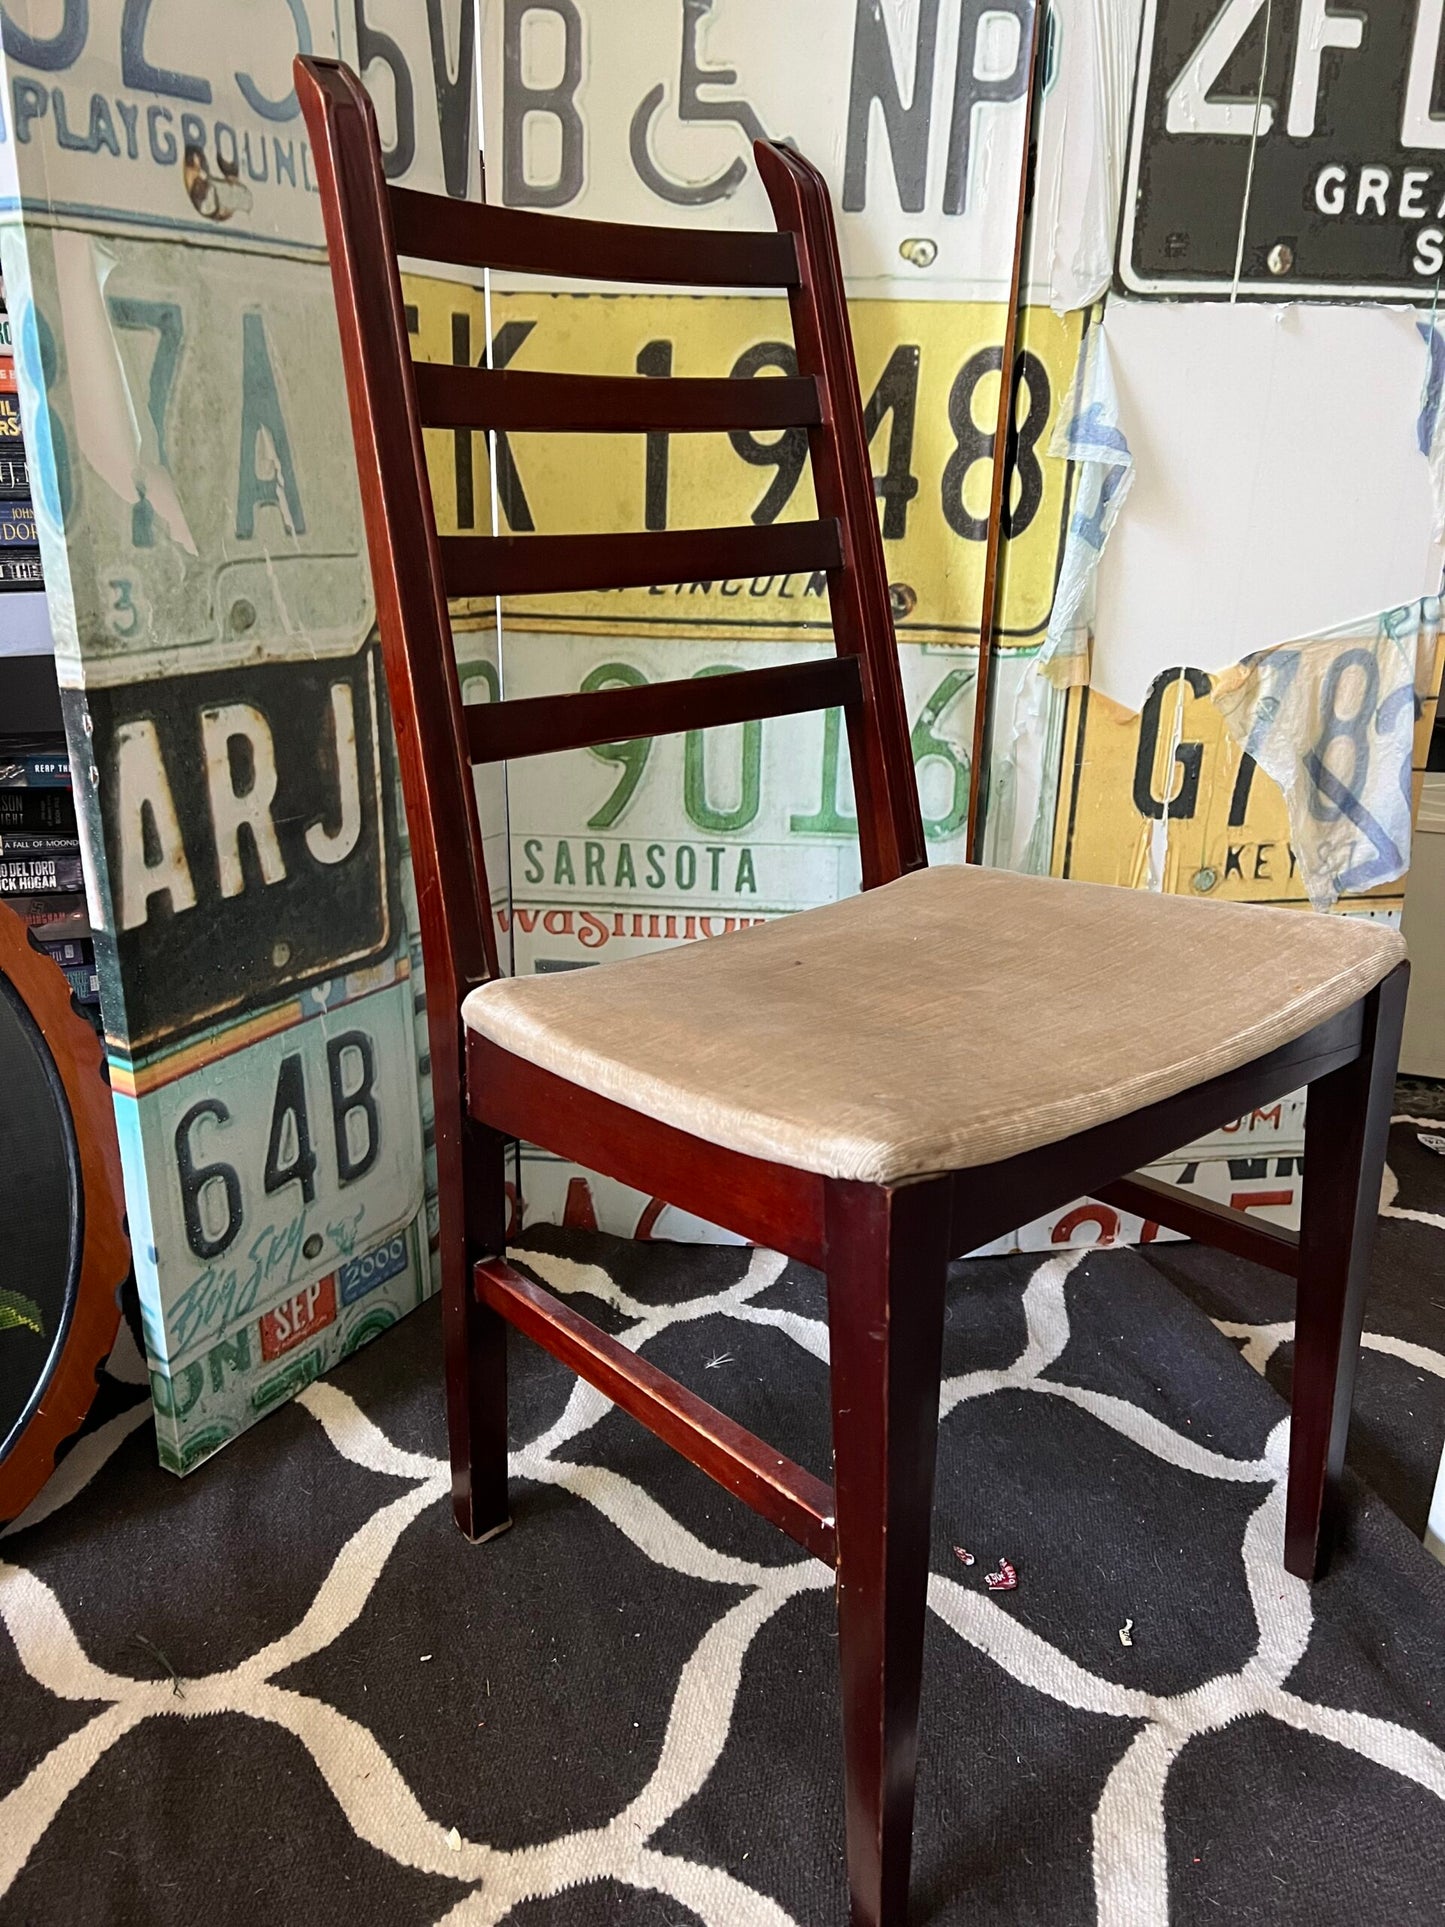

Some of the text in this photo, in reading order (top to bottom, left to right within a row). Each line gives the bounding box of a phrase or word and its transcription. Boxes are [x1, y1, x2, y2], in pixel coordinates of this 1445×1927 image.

[1315, 166, 1445, 218] GRE
[114, 682, 362, 931] ARJ
[13, 841, 29, 849] FALL
[33, 840, 43, 848] OF
[46, 839, 79, 847] MOOND
[524, 837, 758, 894] SARASOTA
[19, 875, 57, 890] HOGAN
[174, 1029, 380, 1261] 64B
[236, 1207, 307, 1318] Sky
[345, 1238, 404, 1288] 2000
[274, 1282, 321, 1342] SEP
